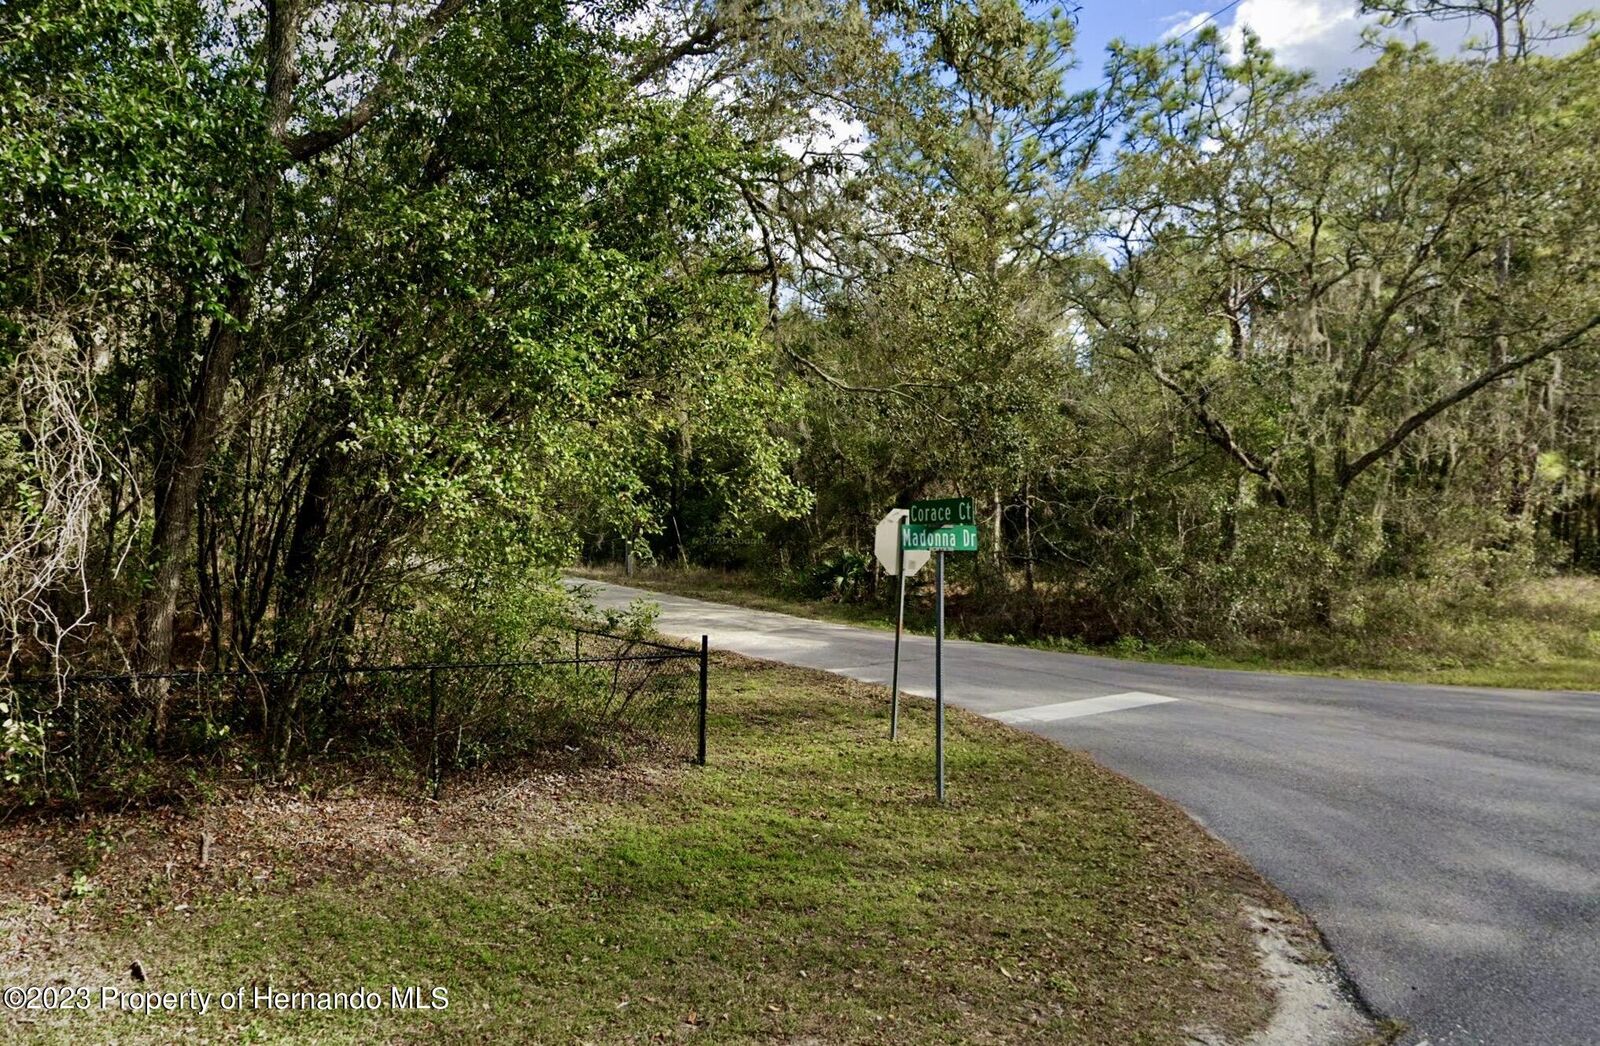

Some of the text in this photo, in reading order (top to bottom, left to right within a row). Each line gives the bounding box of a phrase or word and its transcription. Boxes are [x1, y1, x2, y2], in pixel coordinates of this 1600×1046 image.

[911, 502, 971, 522] Corace Ct
[903, 528, 976, 547] Madonna Dr
